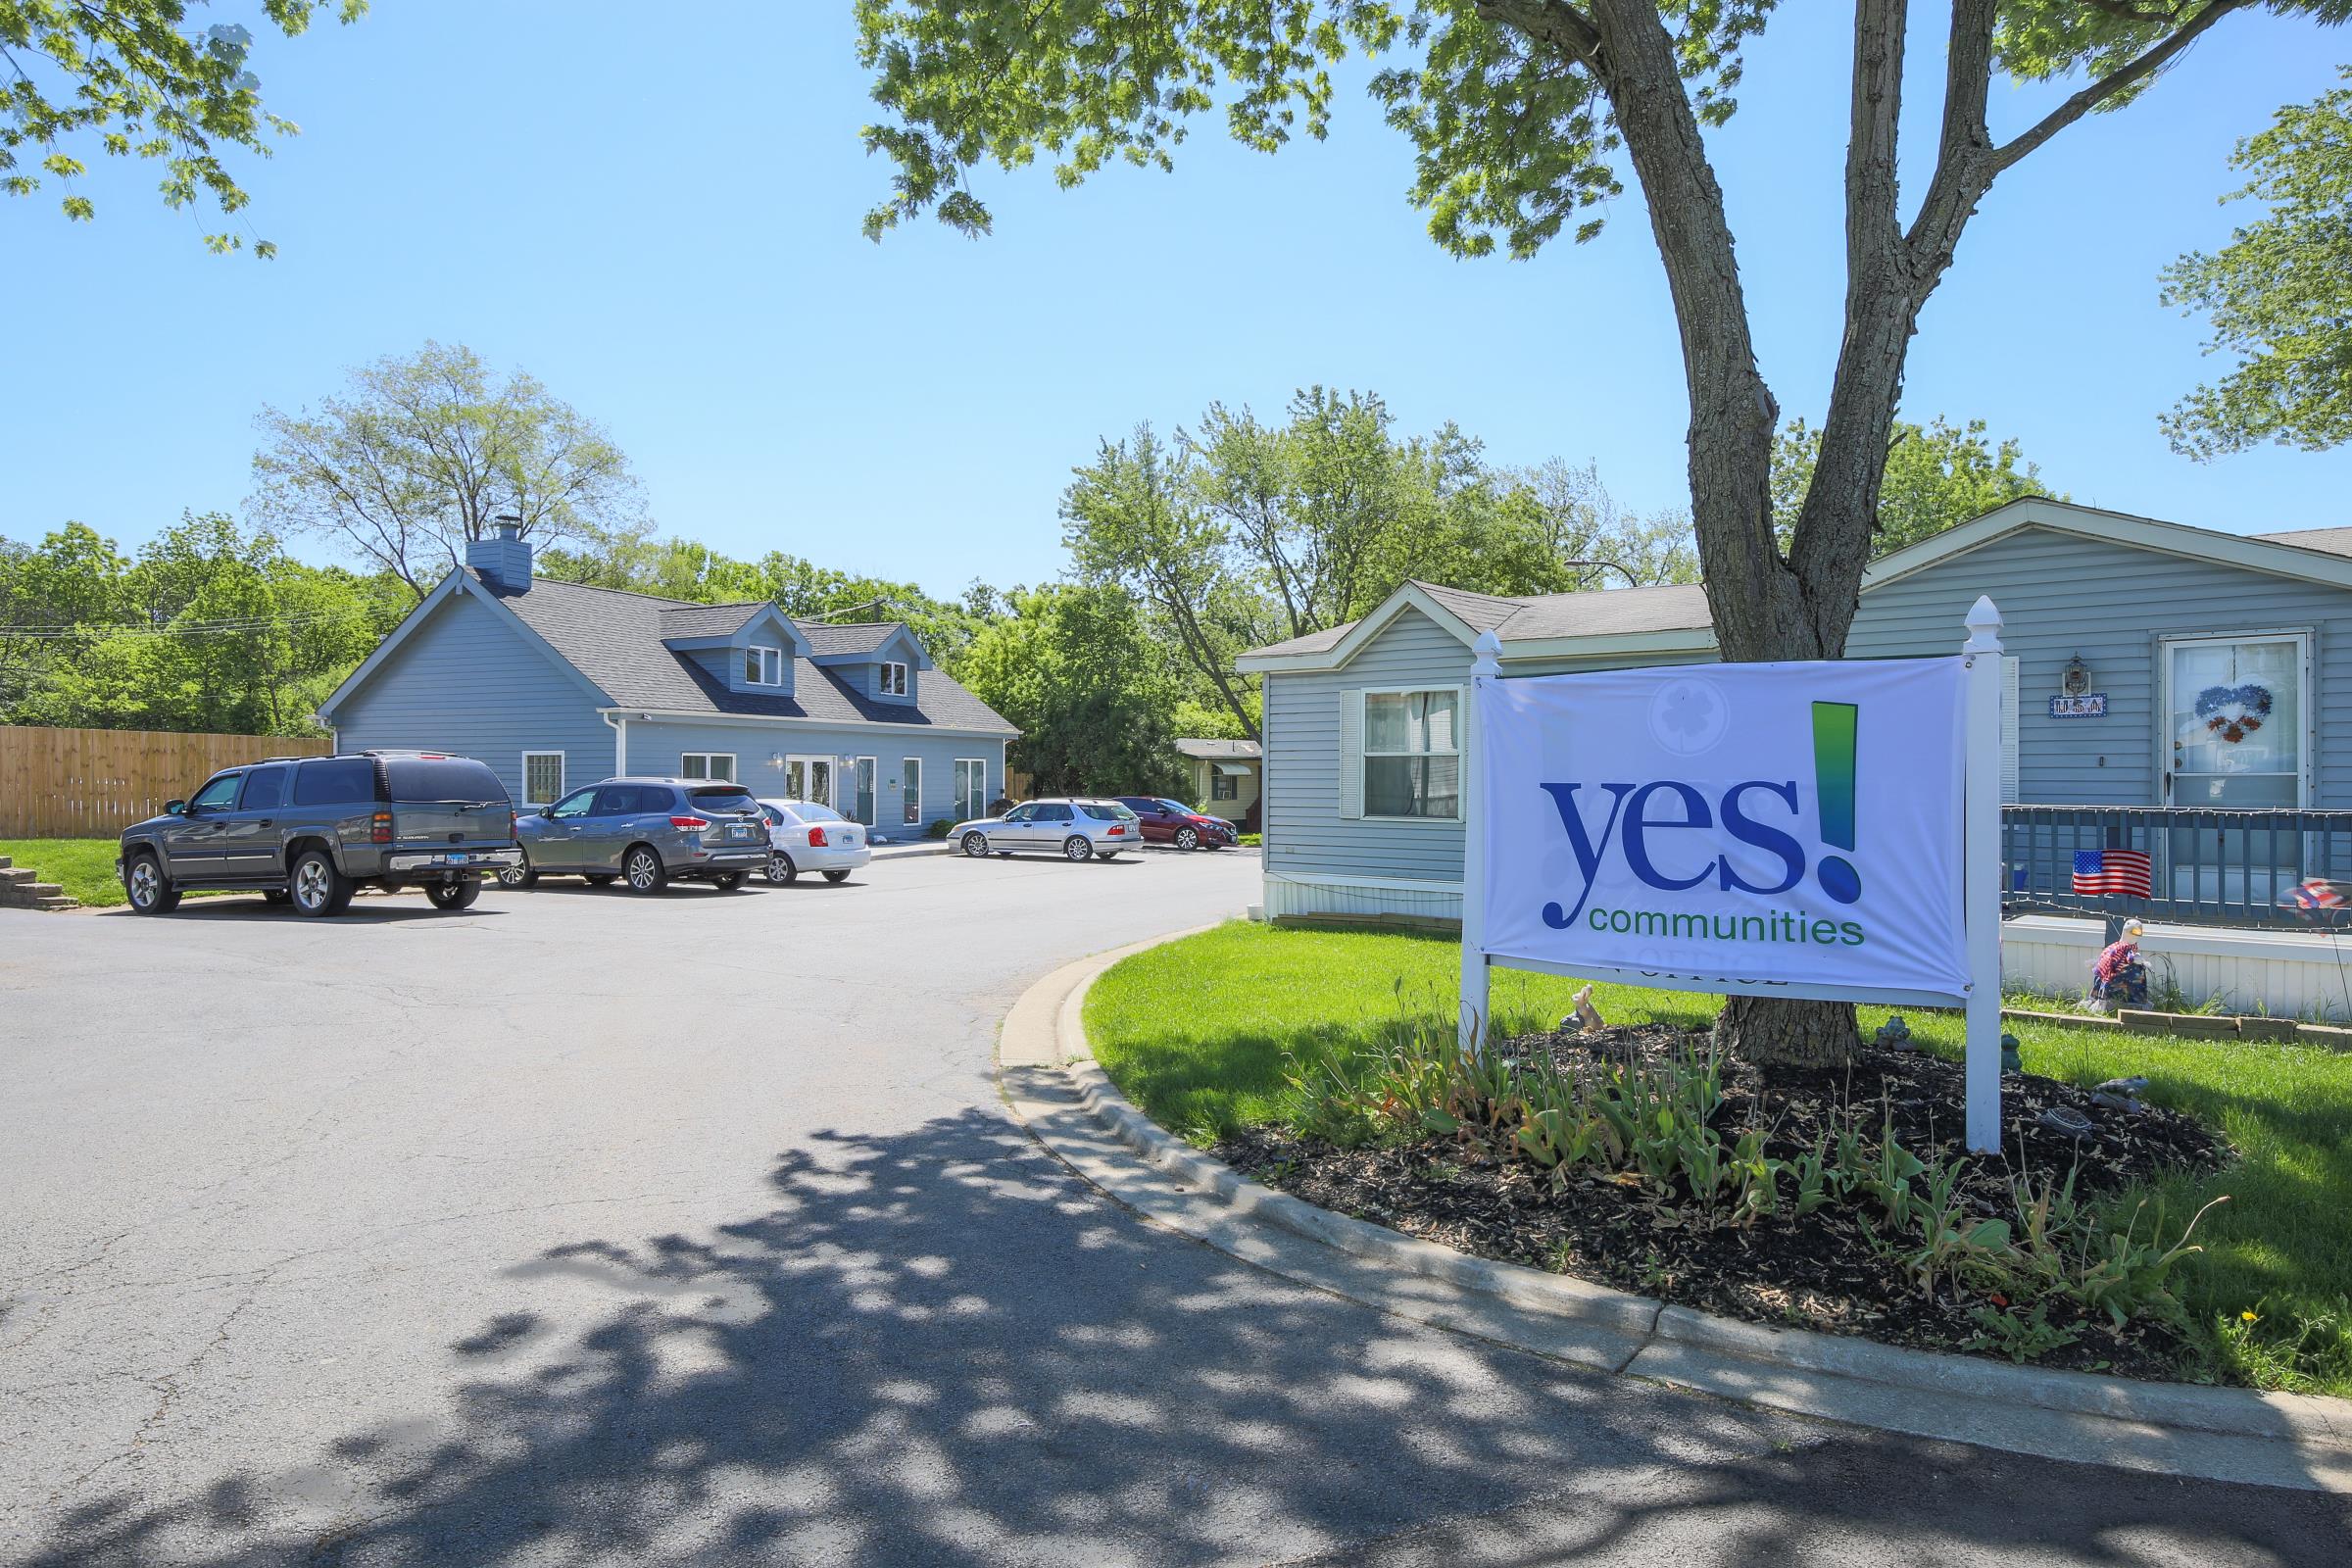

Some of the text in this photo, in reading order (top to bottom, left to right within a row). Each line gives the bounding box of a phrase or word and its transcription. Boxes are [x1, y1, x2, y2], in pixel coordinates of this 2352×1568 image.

[2054, 699, 2102, 713] USA
[1540, 700, 1862, 929] yes!
[1589, 907, 1865, 946] communities
